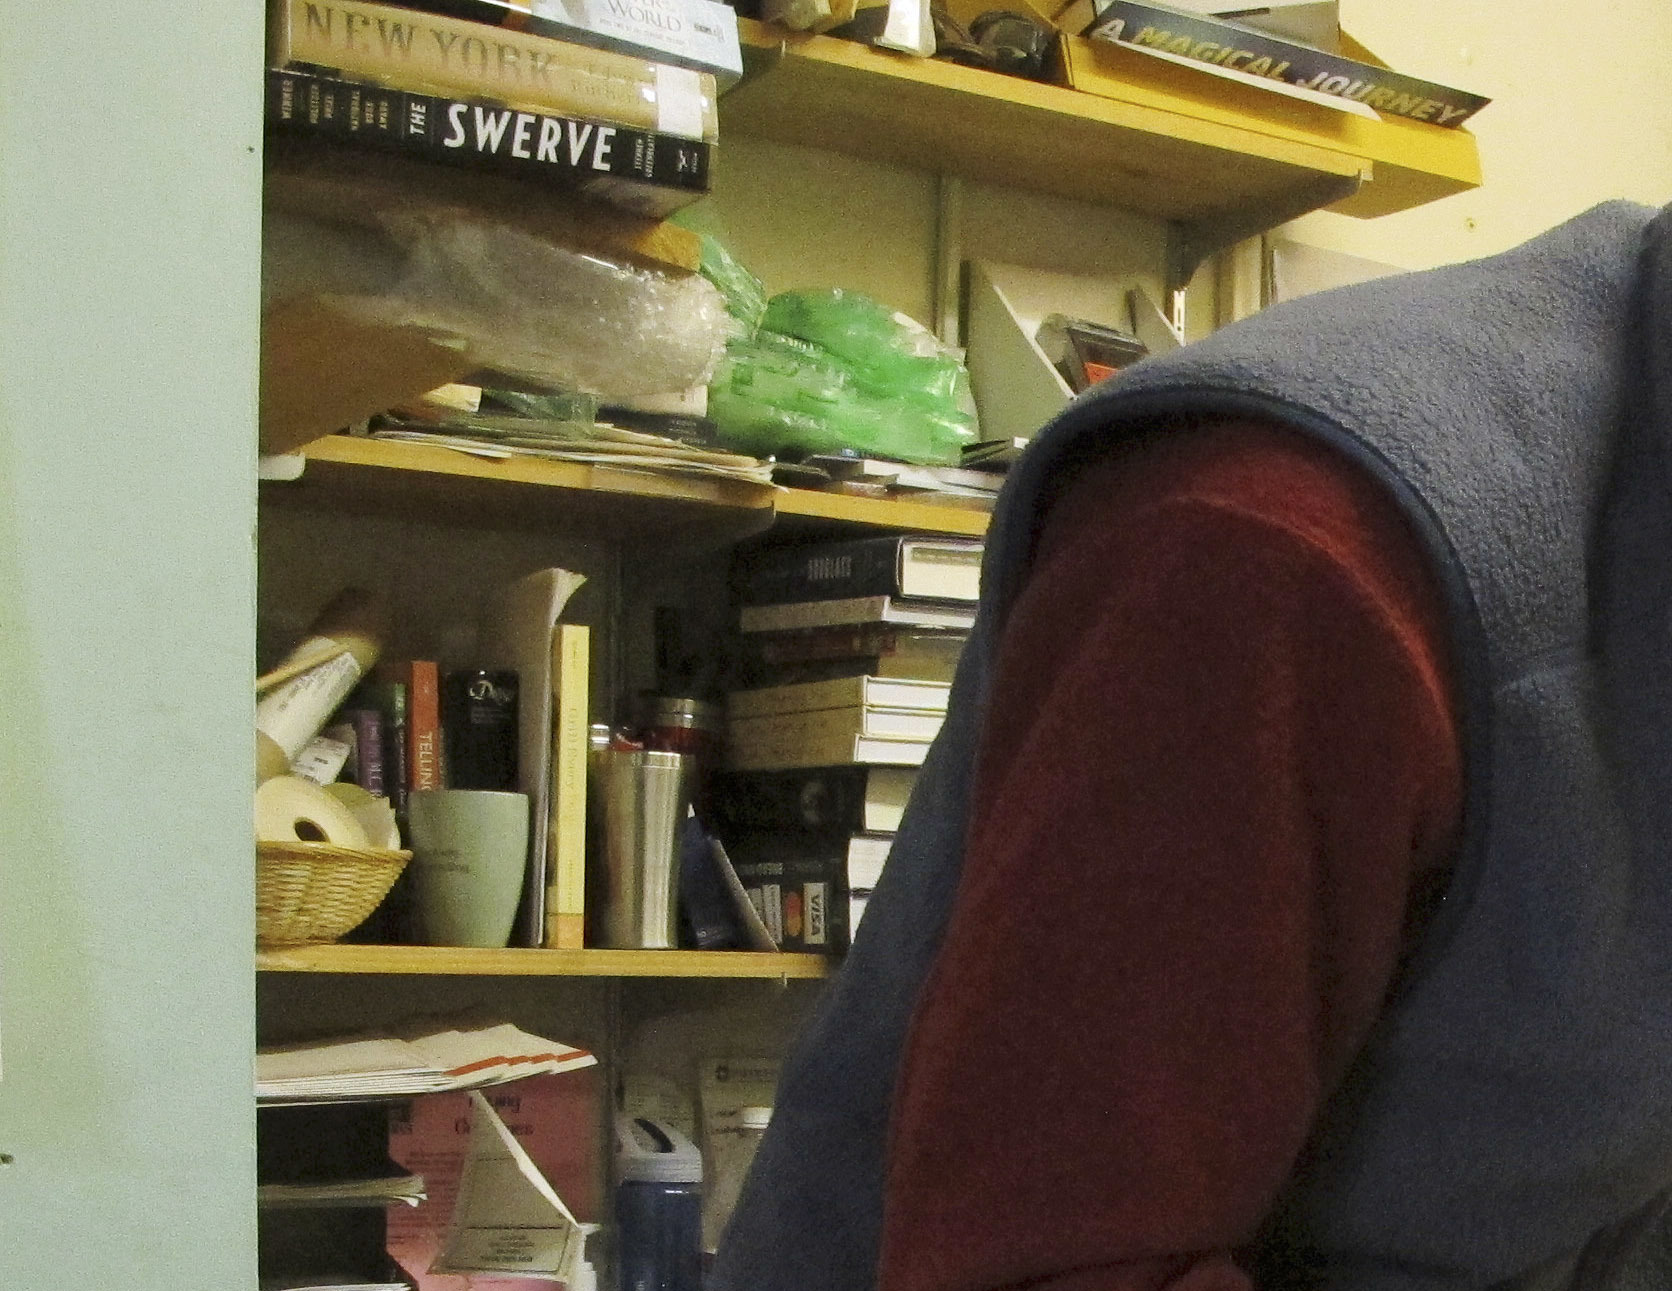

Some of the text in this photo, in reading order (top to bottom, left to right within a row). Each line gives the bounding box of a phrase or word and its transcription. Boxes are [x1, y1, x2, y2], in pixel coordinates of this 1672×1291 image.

[603, 0, 682, 33] WORLD
[303, 7, 416, 53] NEW
[427, 28, 562, 85] YORK
[1094, 18, 1470, 126] A MAGICAL JOURNEY
[409, 102, 427, 135] THE
[443, 103, 617, 172] SWERVE
[809, 894, 822, 936] VISA
